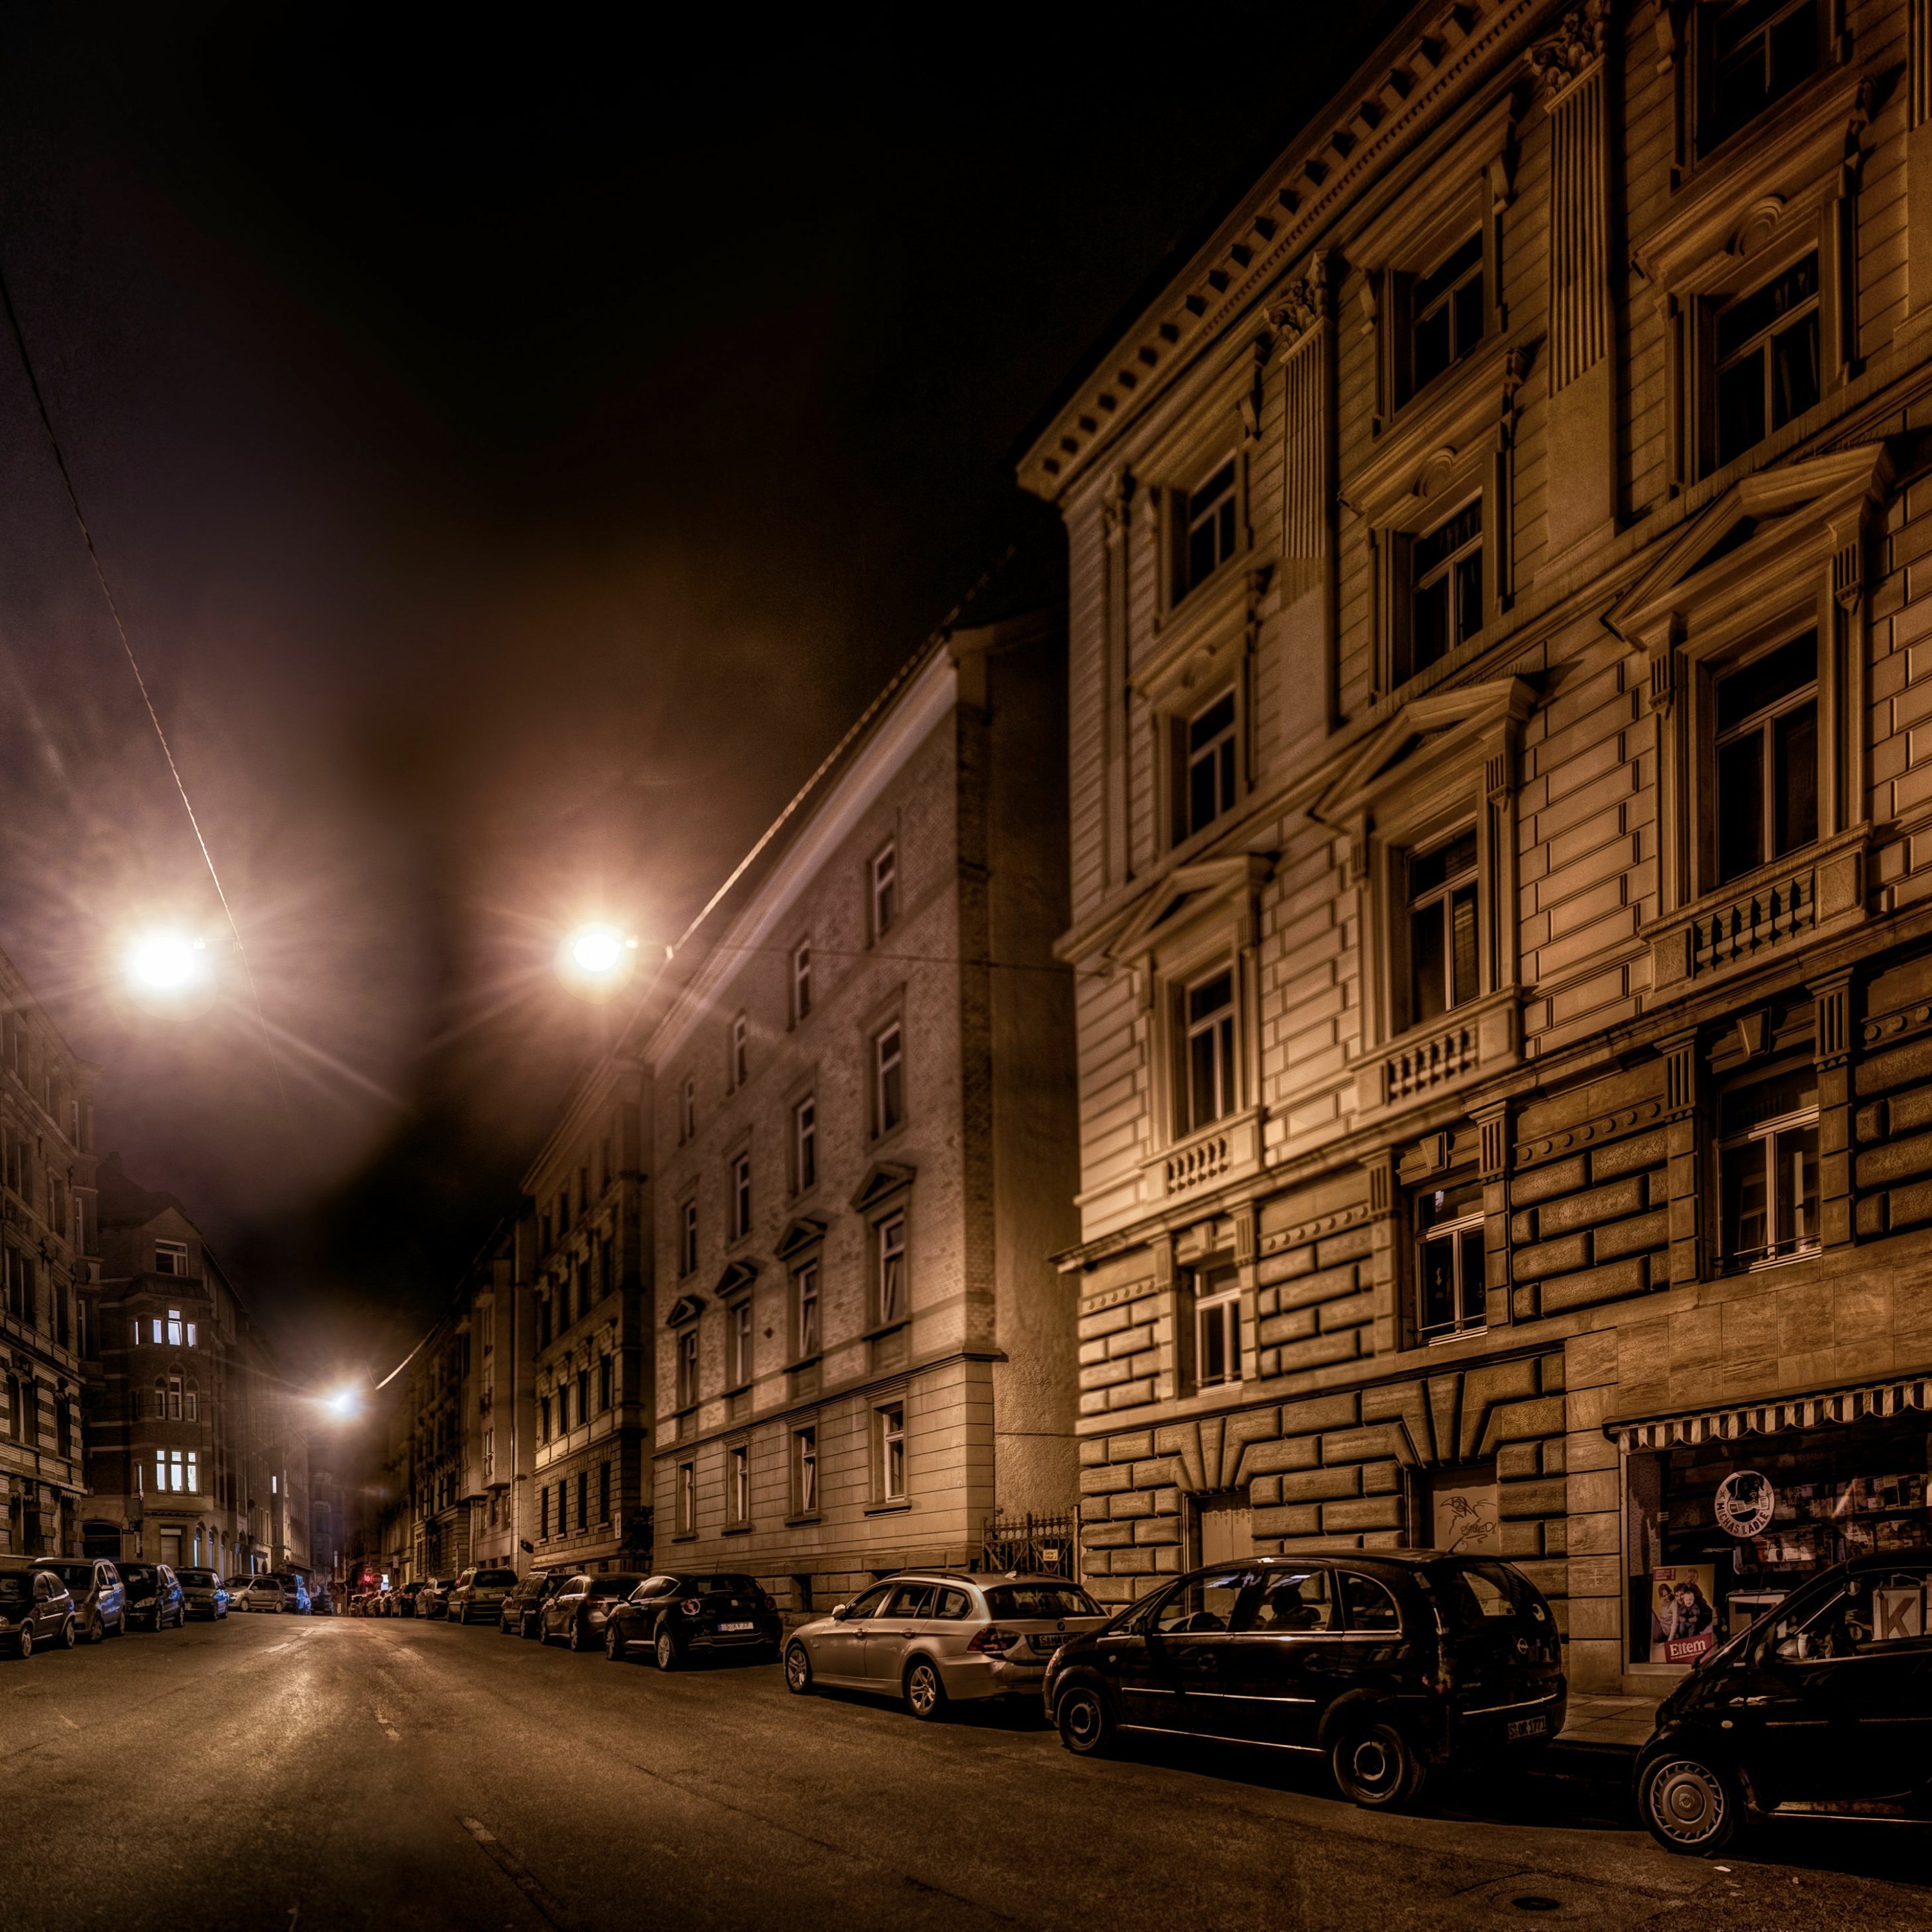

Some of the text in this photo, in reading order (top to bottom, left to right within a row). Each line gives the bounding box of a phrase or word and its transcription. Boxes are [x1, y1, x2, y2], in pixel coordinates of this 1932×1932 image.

[1717, 1502, 1769, 1535] MICHAS LÄDLE
[1880, 1598, 1916, 1639] K
